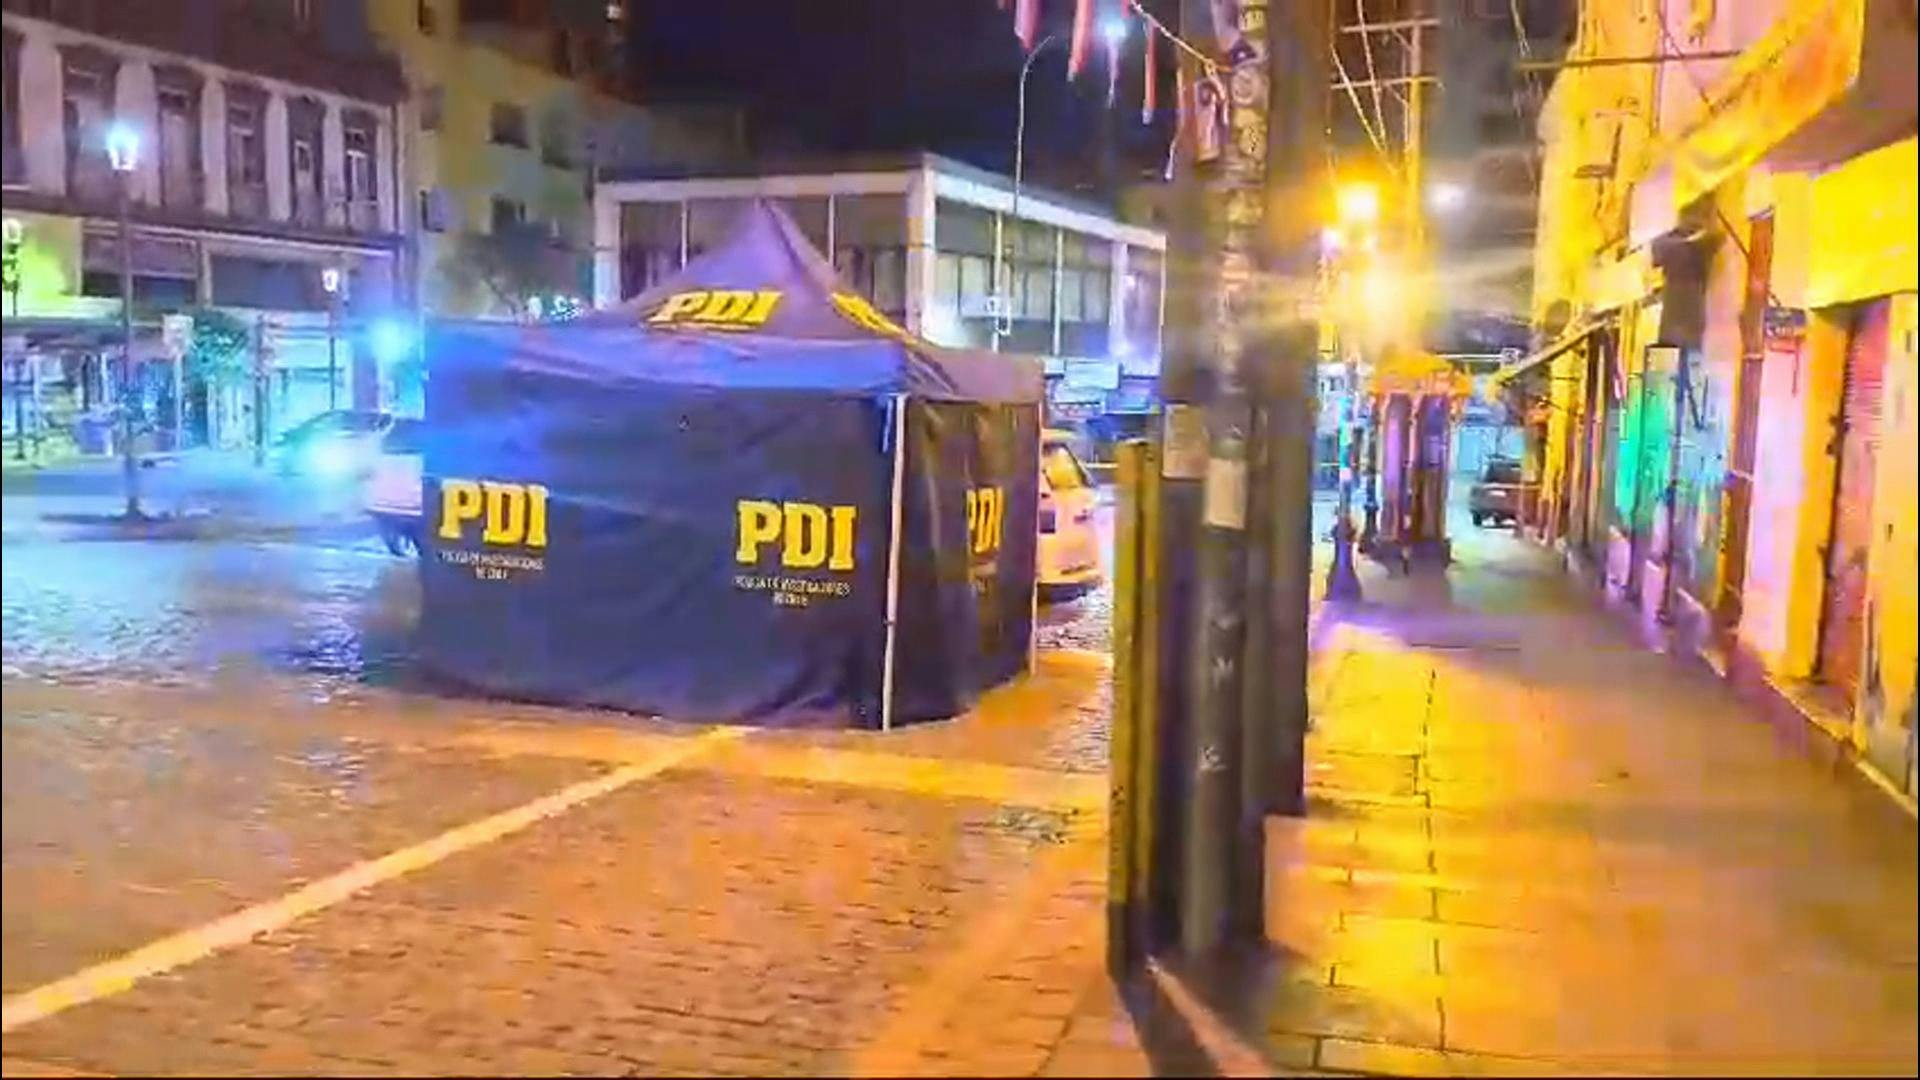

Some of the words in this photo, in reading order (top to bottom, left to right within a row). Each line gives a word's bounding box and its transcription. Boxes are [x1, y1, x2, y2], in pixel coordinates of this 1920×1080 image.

[648, 290, 782, 324] PDI
[439, 479, 549, 547] PDI
[736, 500, 856, 570] PDI
